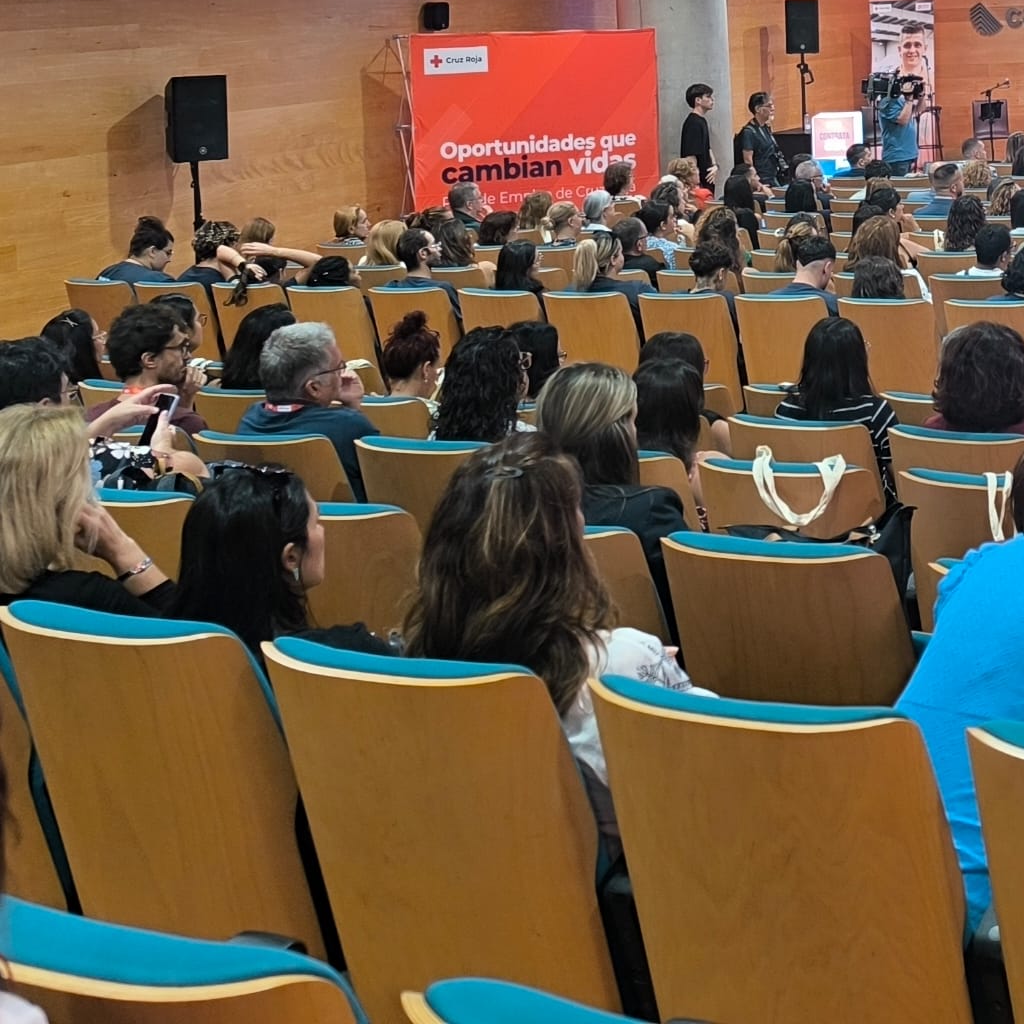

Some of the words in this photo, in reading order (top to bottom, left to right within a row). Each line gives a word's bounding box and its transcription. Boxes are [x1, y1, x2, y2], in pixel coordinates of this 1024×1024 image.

[465, 56, 482, 64] Roja
[440, 132, 596, 161] Oportunidades
[600, 132, 637, 152] que
[441, 155, 562, 185] cambian
[555, 187, 573, 199] de
